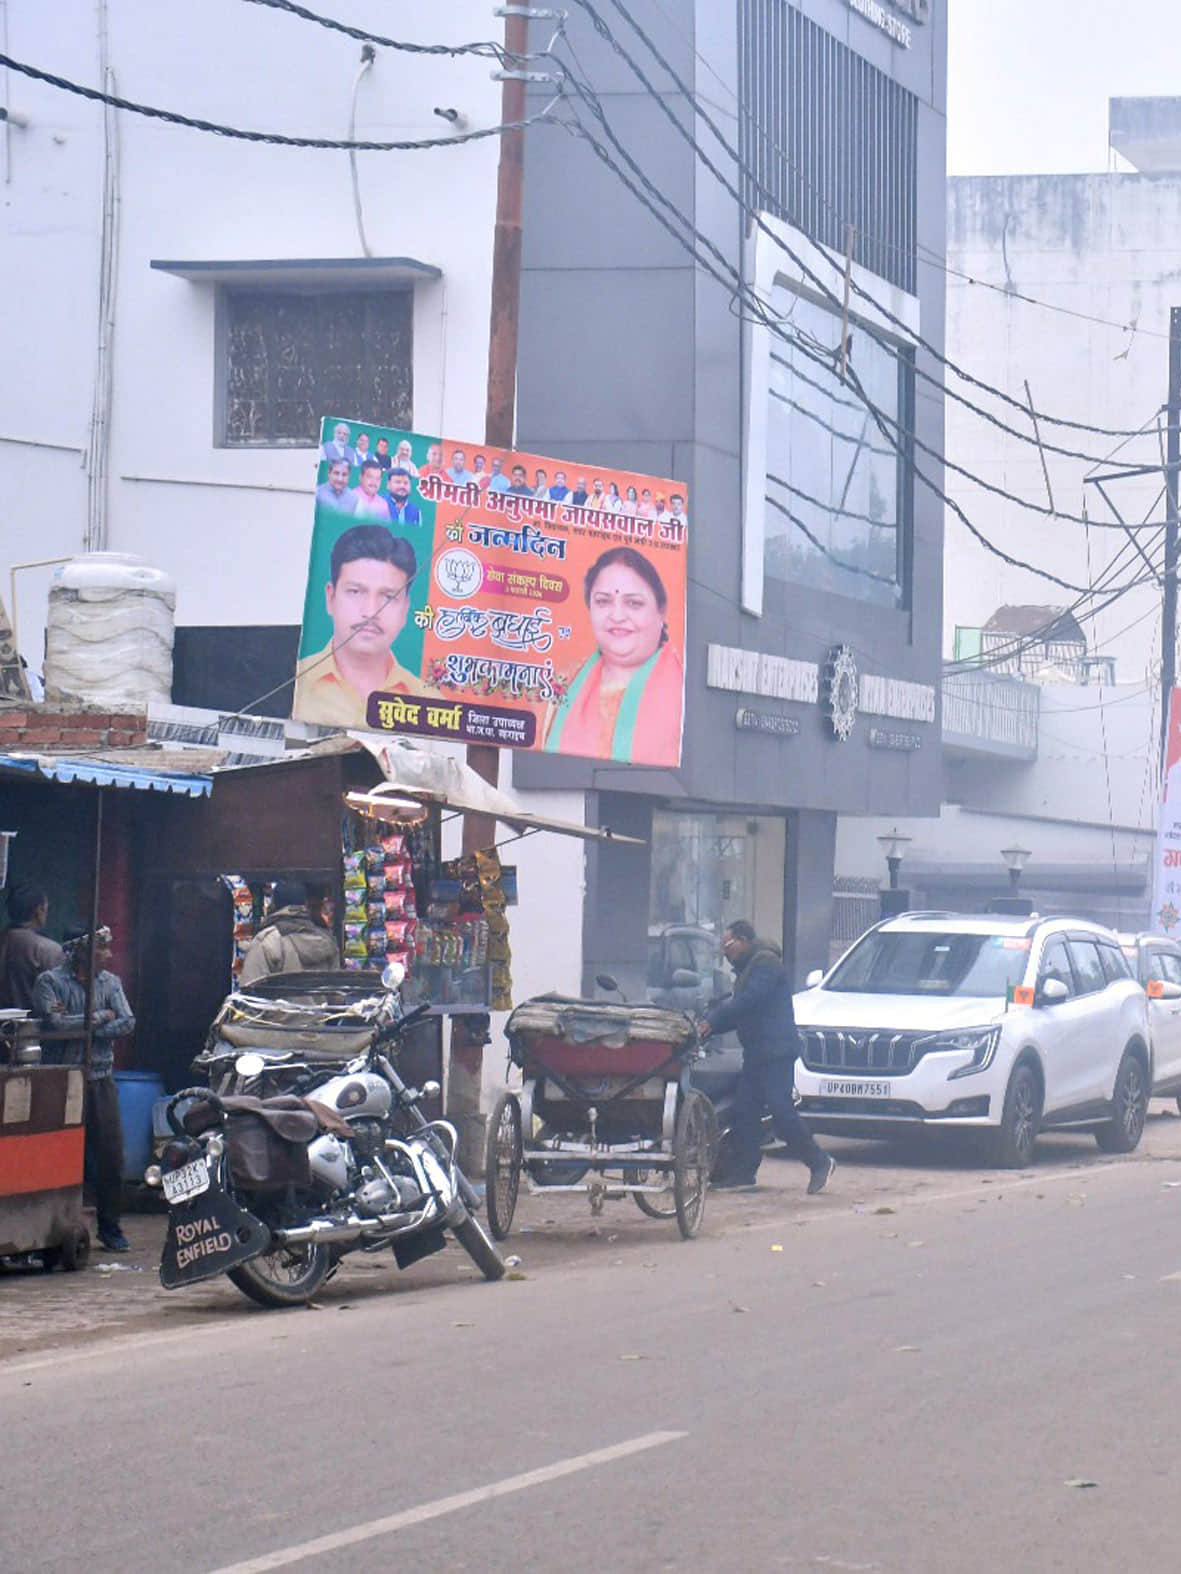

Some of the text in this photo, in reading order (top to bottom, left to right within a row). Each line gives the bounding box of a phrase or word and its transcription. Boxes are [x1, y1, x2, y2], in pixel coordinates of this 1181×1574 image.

[418, 476, 684, 542] श्रीमती अनुपमा जायसवाल जी
[468, 523, 567, 560] जन्मदिन
[539, 575, 563, 592] दिवस
[414, 605, 434, 631] की
[426, 705, 463, 731] वर्मा
[176, 1215, 220, 1246] ROYAL
[176, 1232, 231, 1269] ENFIELD
